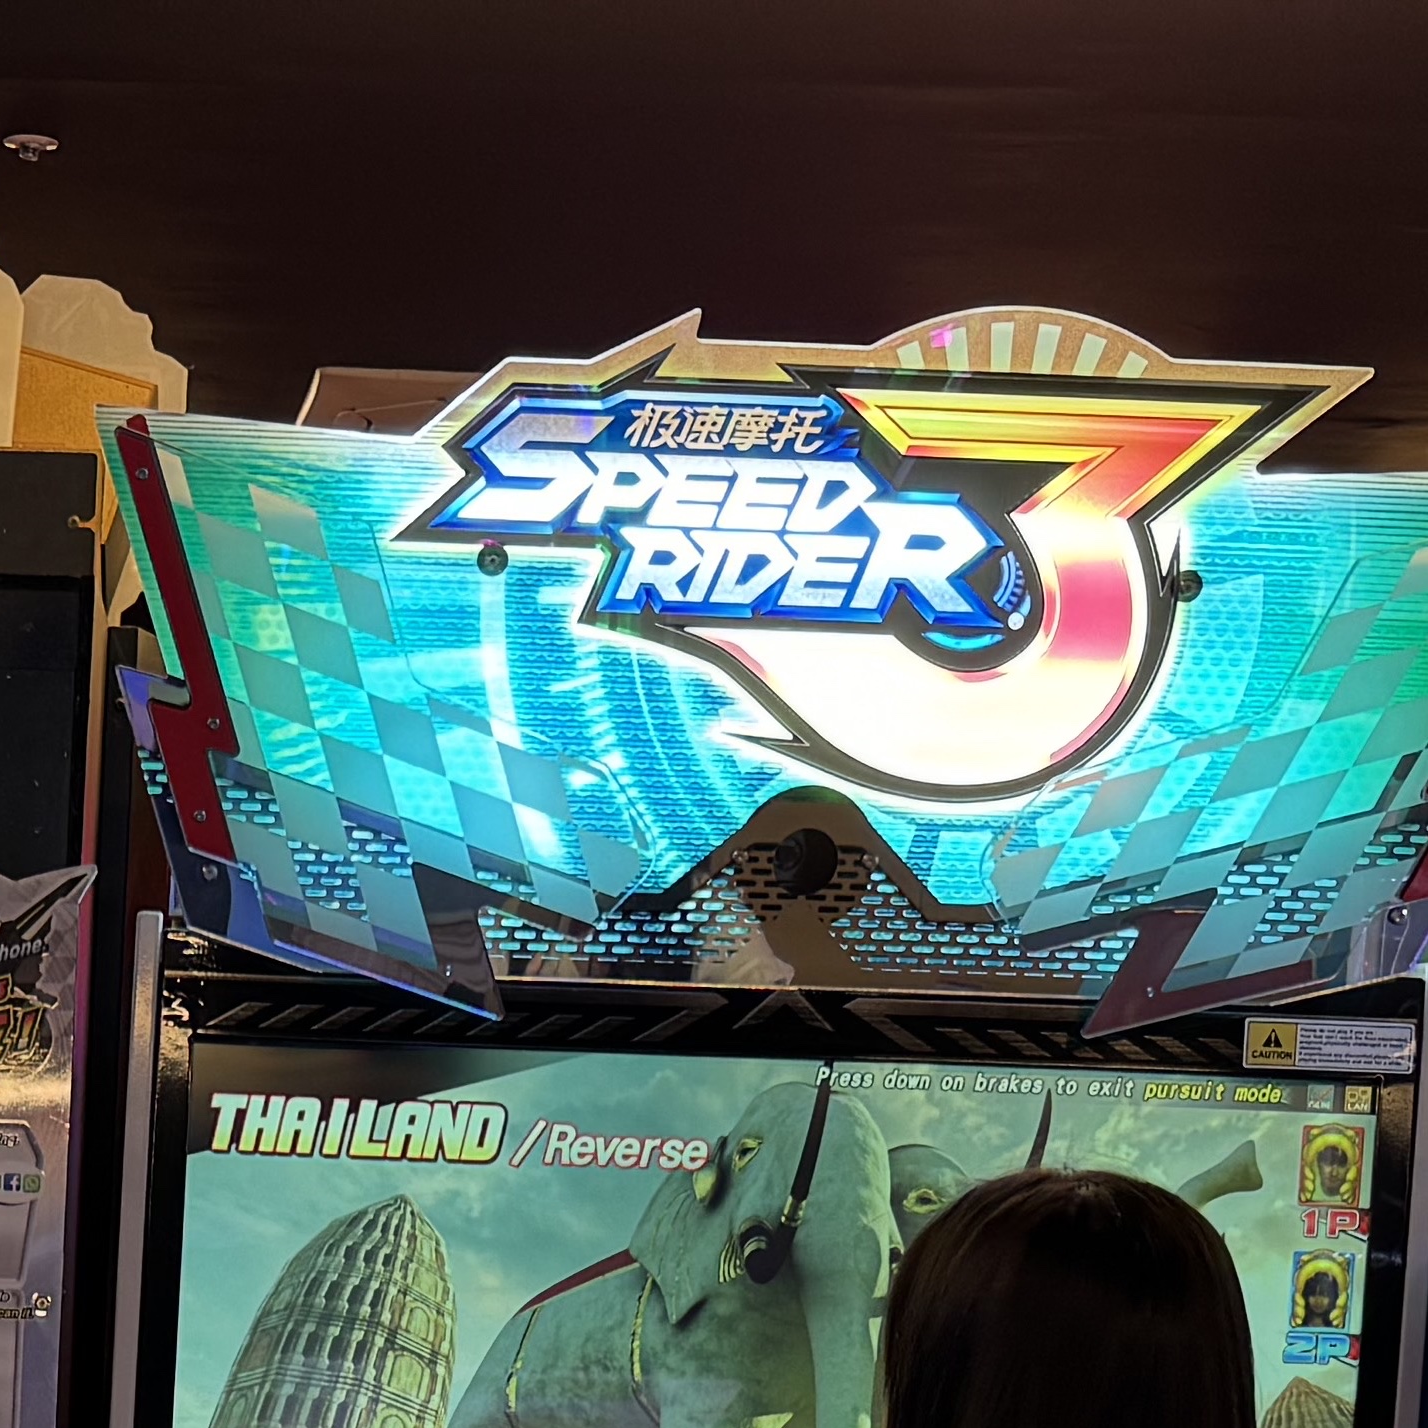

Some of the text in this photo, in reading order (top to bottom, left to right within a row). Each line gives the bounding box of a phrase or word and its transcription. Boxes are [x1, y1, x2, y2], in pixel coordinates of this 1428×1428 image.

[624, 403, 828, 454] 极速摩托
[454, 416, 880, 531] SPEED
[615, 502, 988, 613] RIDER
[1251, 1050, 1293, 1060] CAUTION
[815, 1066, 875, 1089] Press
[884, 1070, 931, 1090] down
[941, 1075, 964, 1092] on
[974, 1071, 1043, 1094] brakes
[1056, 1075, 1078, 1095] to
[1088, 1077, 1136, 1098] exit
[1144, 1080, 1225, 1103] pursuit
[211, 1092, 508, 1163] THAILAND
[1348, 1103, 1368, 1112] LAN
[1283, 1332, 1350, 1364] 2P
